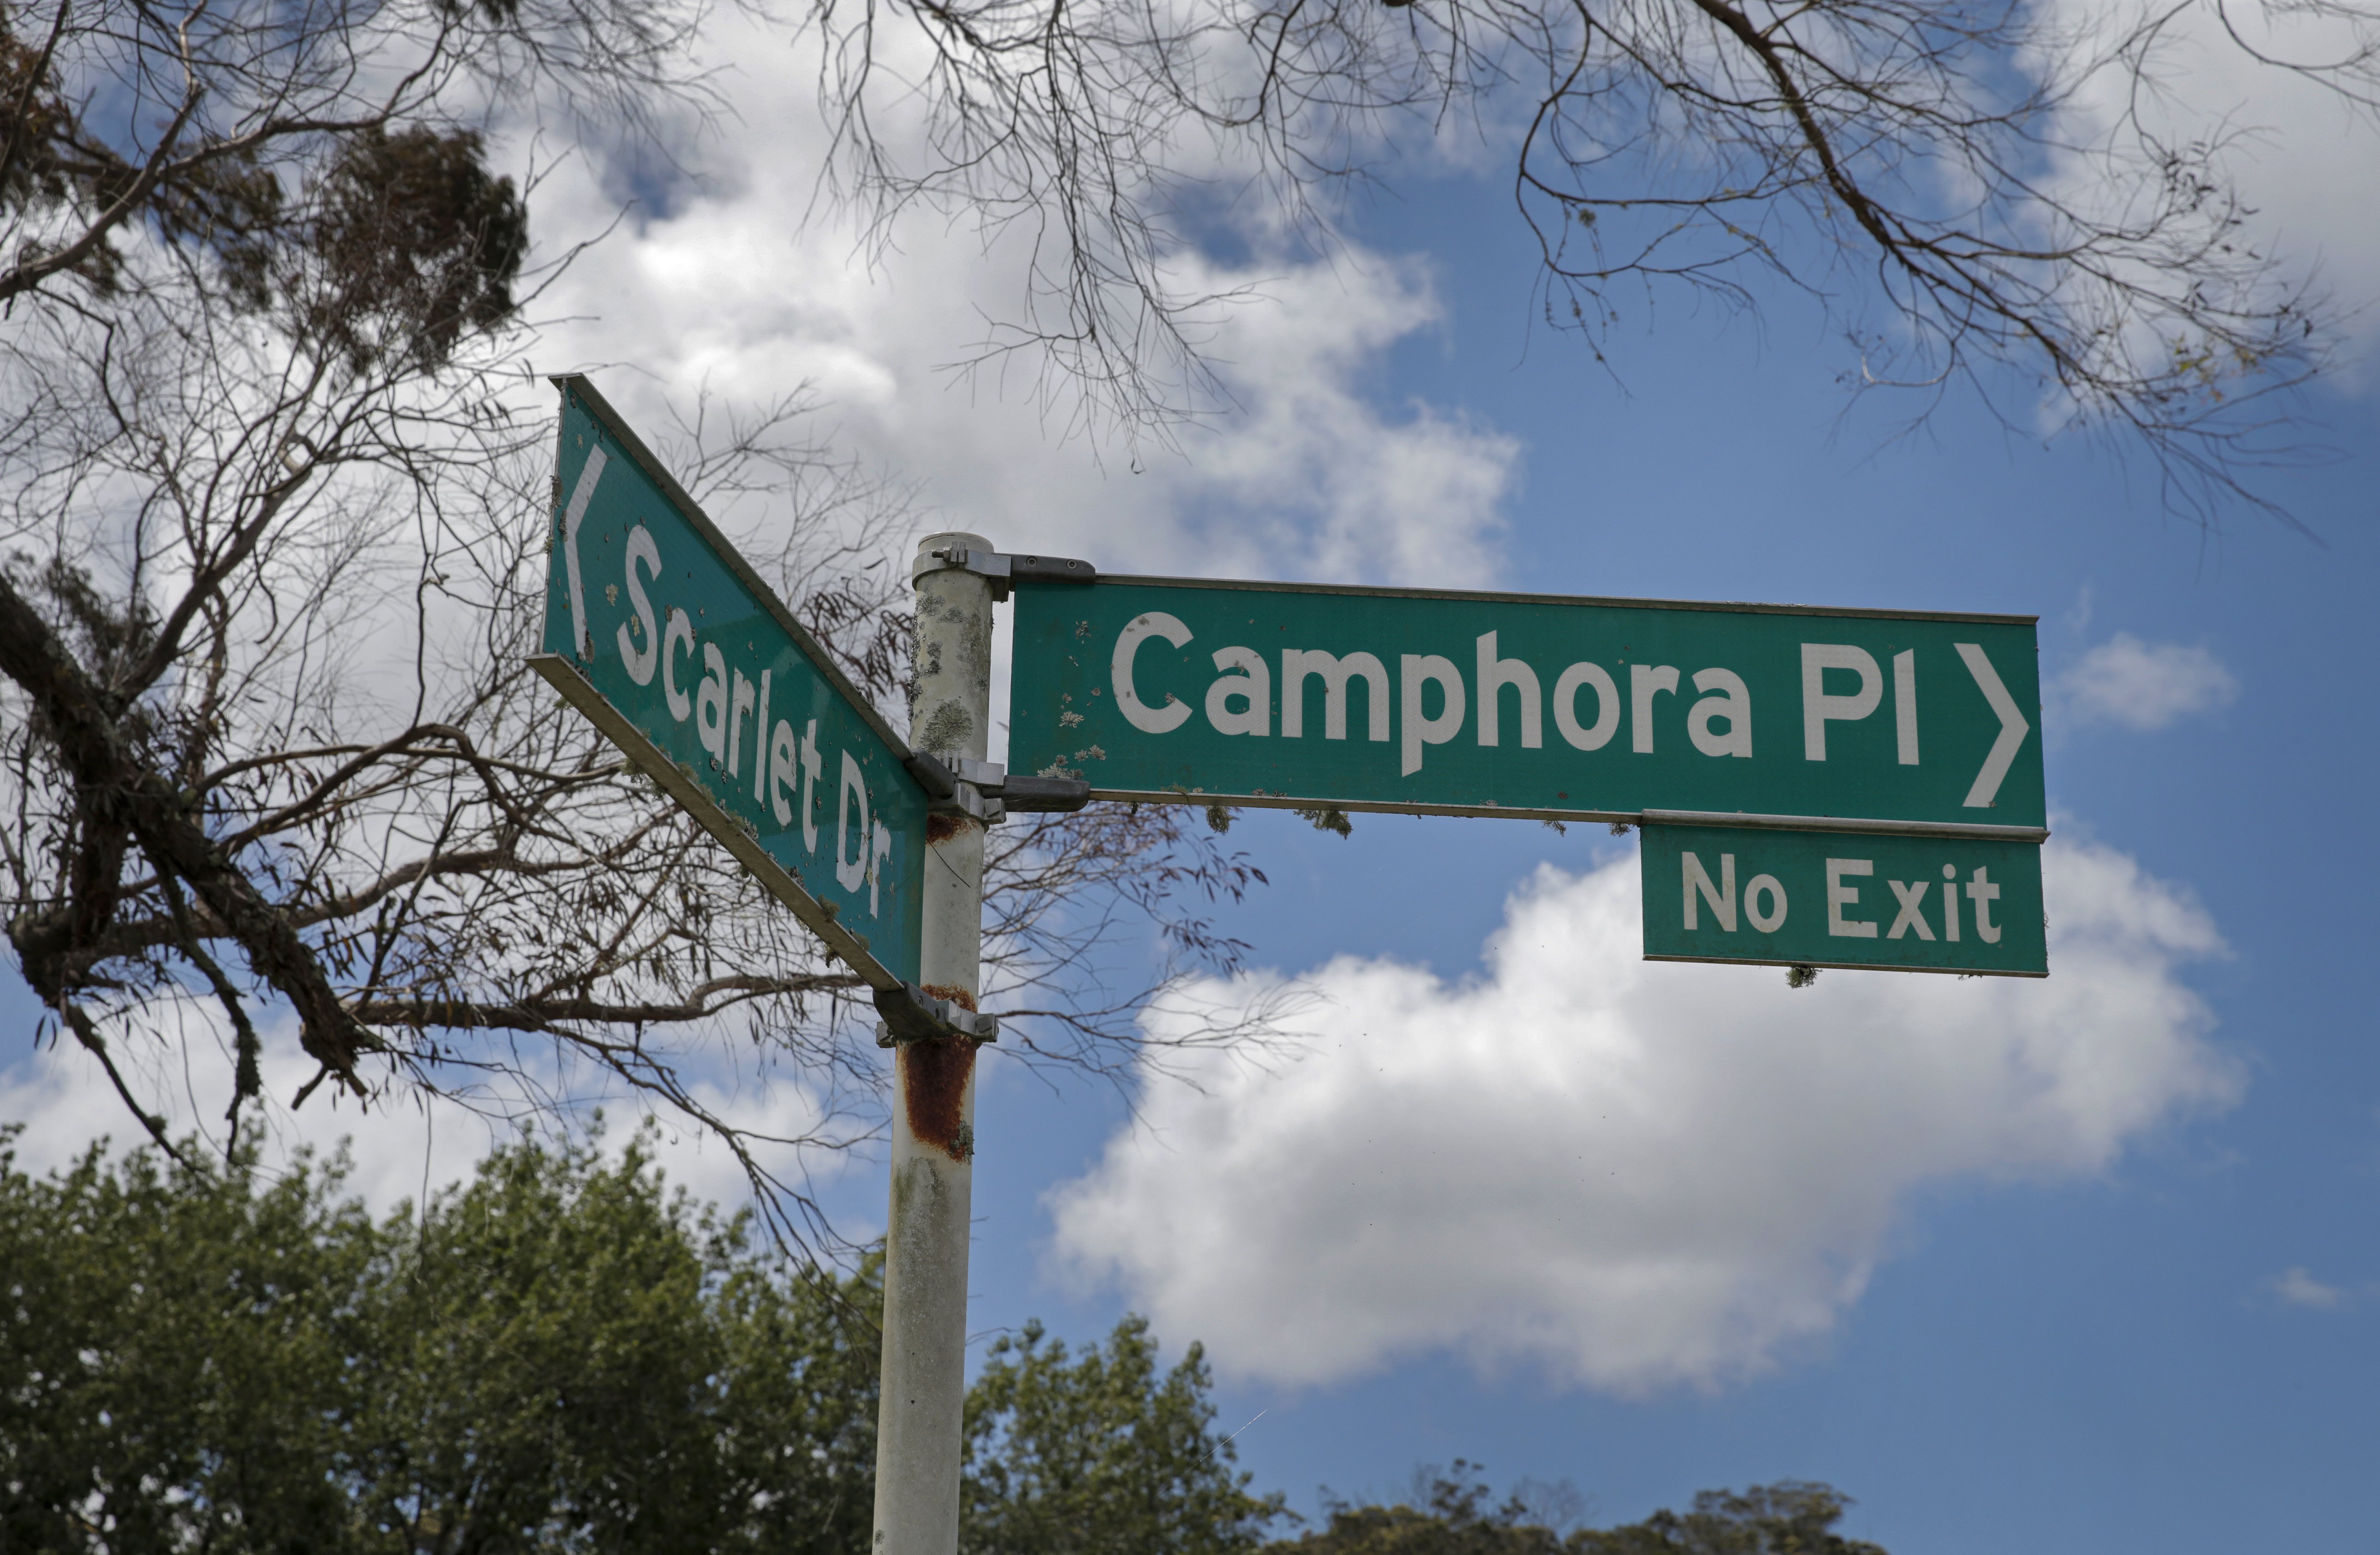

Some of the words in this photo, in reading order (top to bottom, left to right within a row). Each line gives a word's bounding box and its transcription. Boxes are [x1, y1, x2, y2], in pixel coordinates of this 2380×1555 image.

[617, 525, 821, 853] Scarlet
[836, 749, 891, 919] Dr
[1111, 611, 1752, 778] Camphora
[1801, 643, 1919, 765] Pl
[1682, 851, 1787, 933] No
[1826, 858, 2001, 943] Exit
